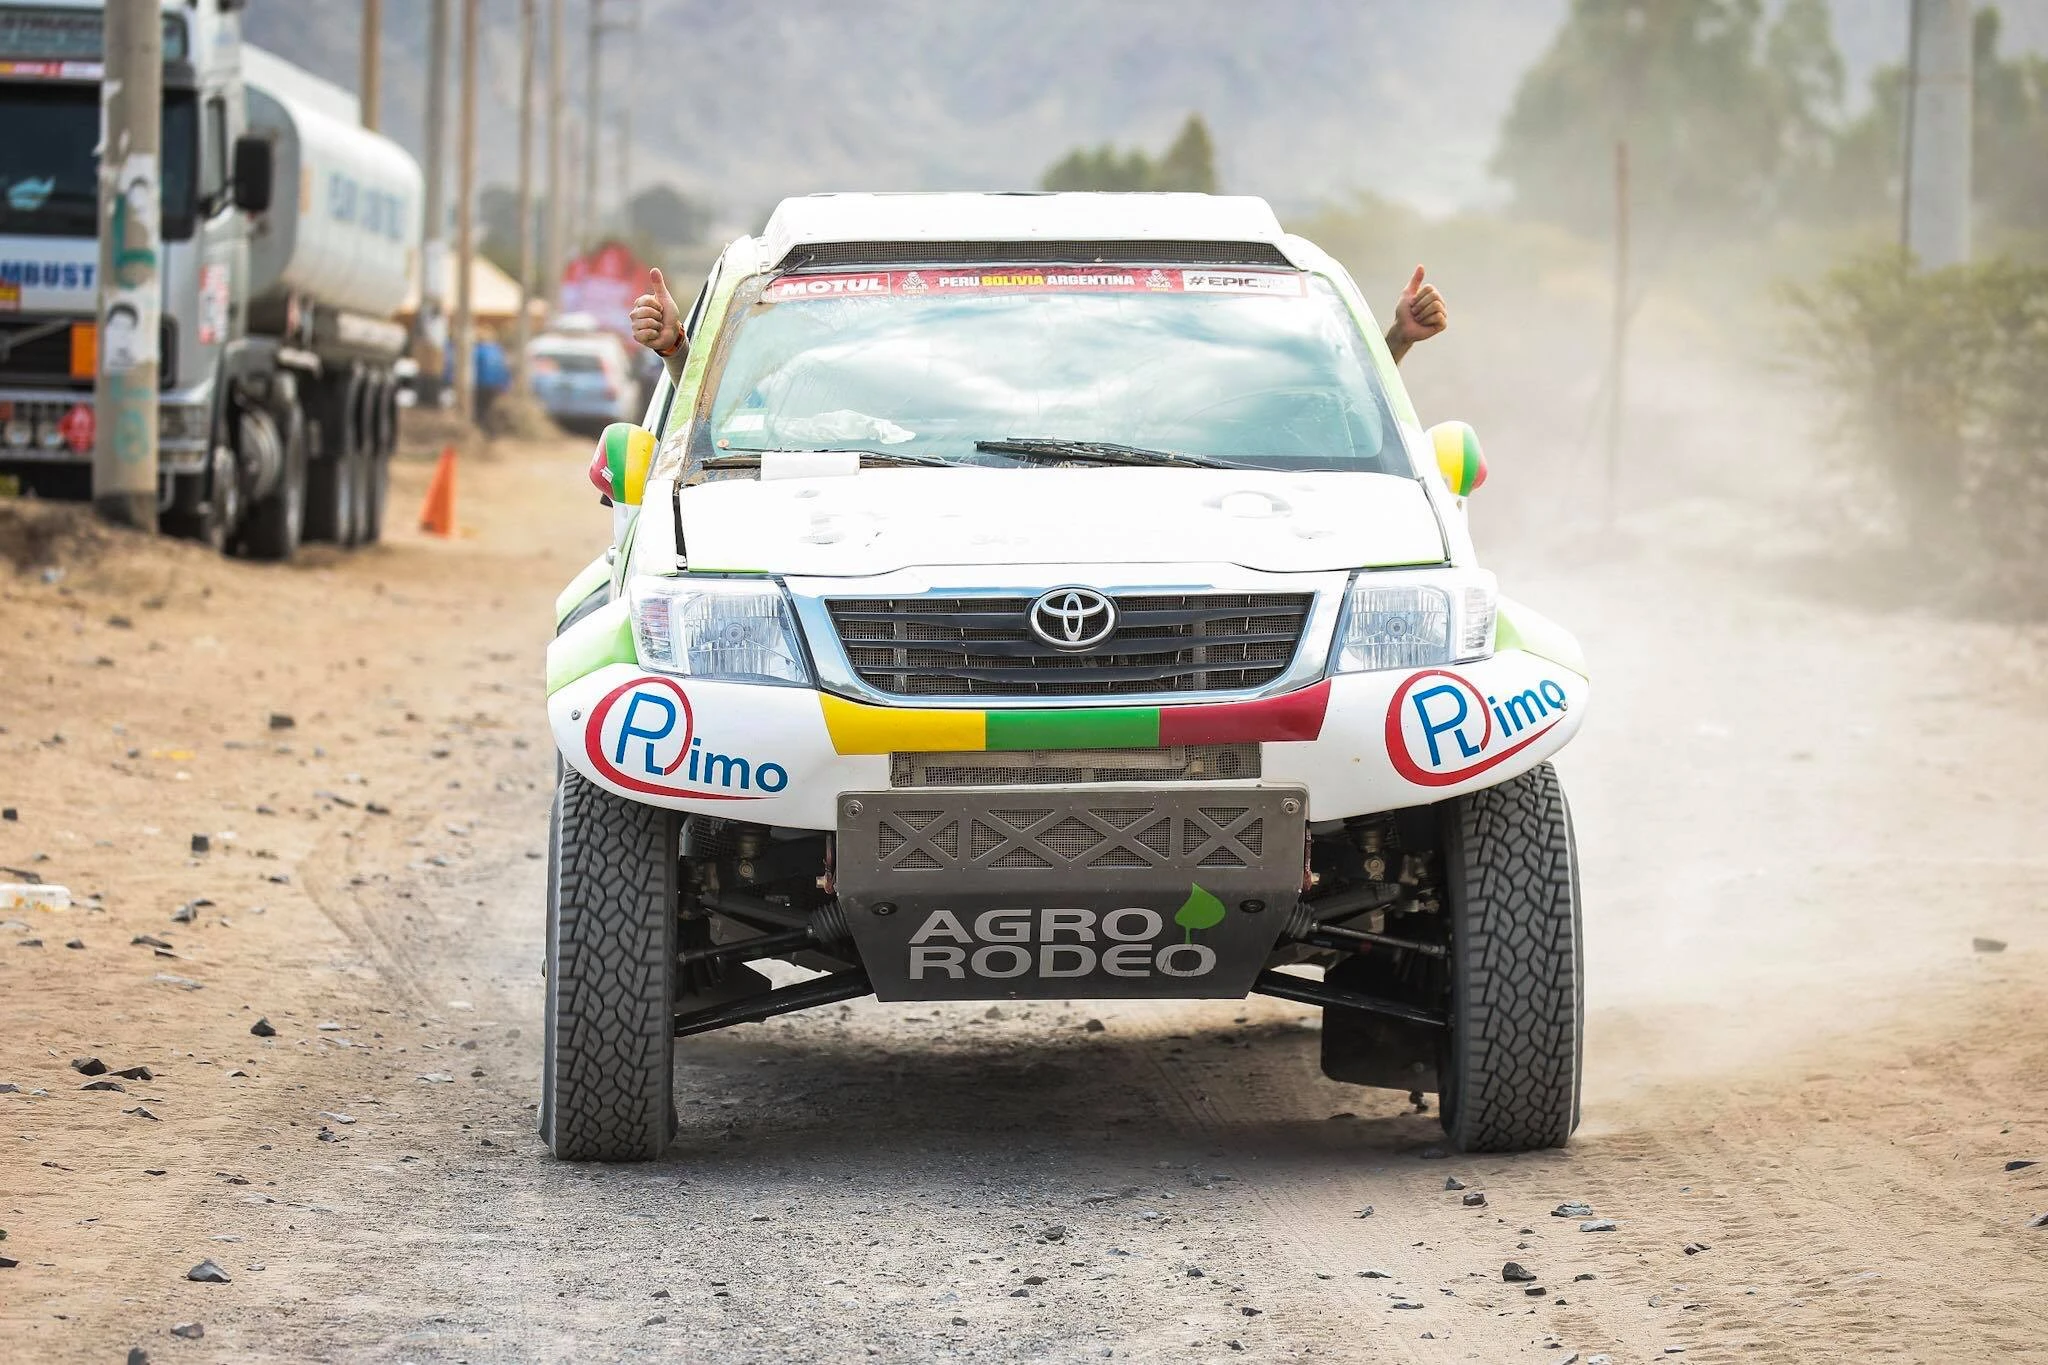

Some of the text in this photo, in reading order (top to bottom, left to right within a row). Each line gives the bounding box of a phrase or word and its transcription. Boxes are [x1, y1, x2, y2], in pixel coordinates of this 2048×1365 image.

[781, 278, 882, 296] MOTUL
[939, 275, 1135, 288] PERU BOLIVIA ARGENTINA
[908, 908, 1163, 944] AGRO
[908, 944, 1217, 980] RODEO
